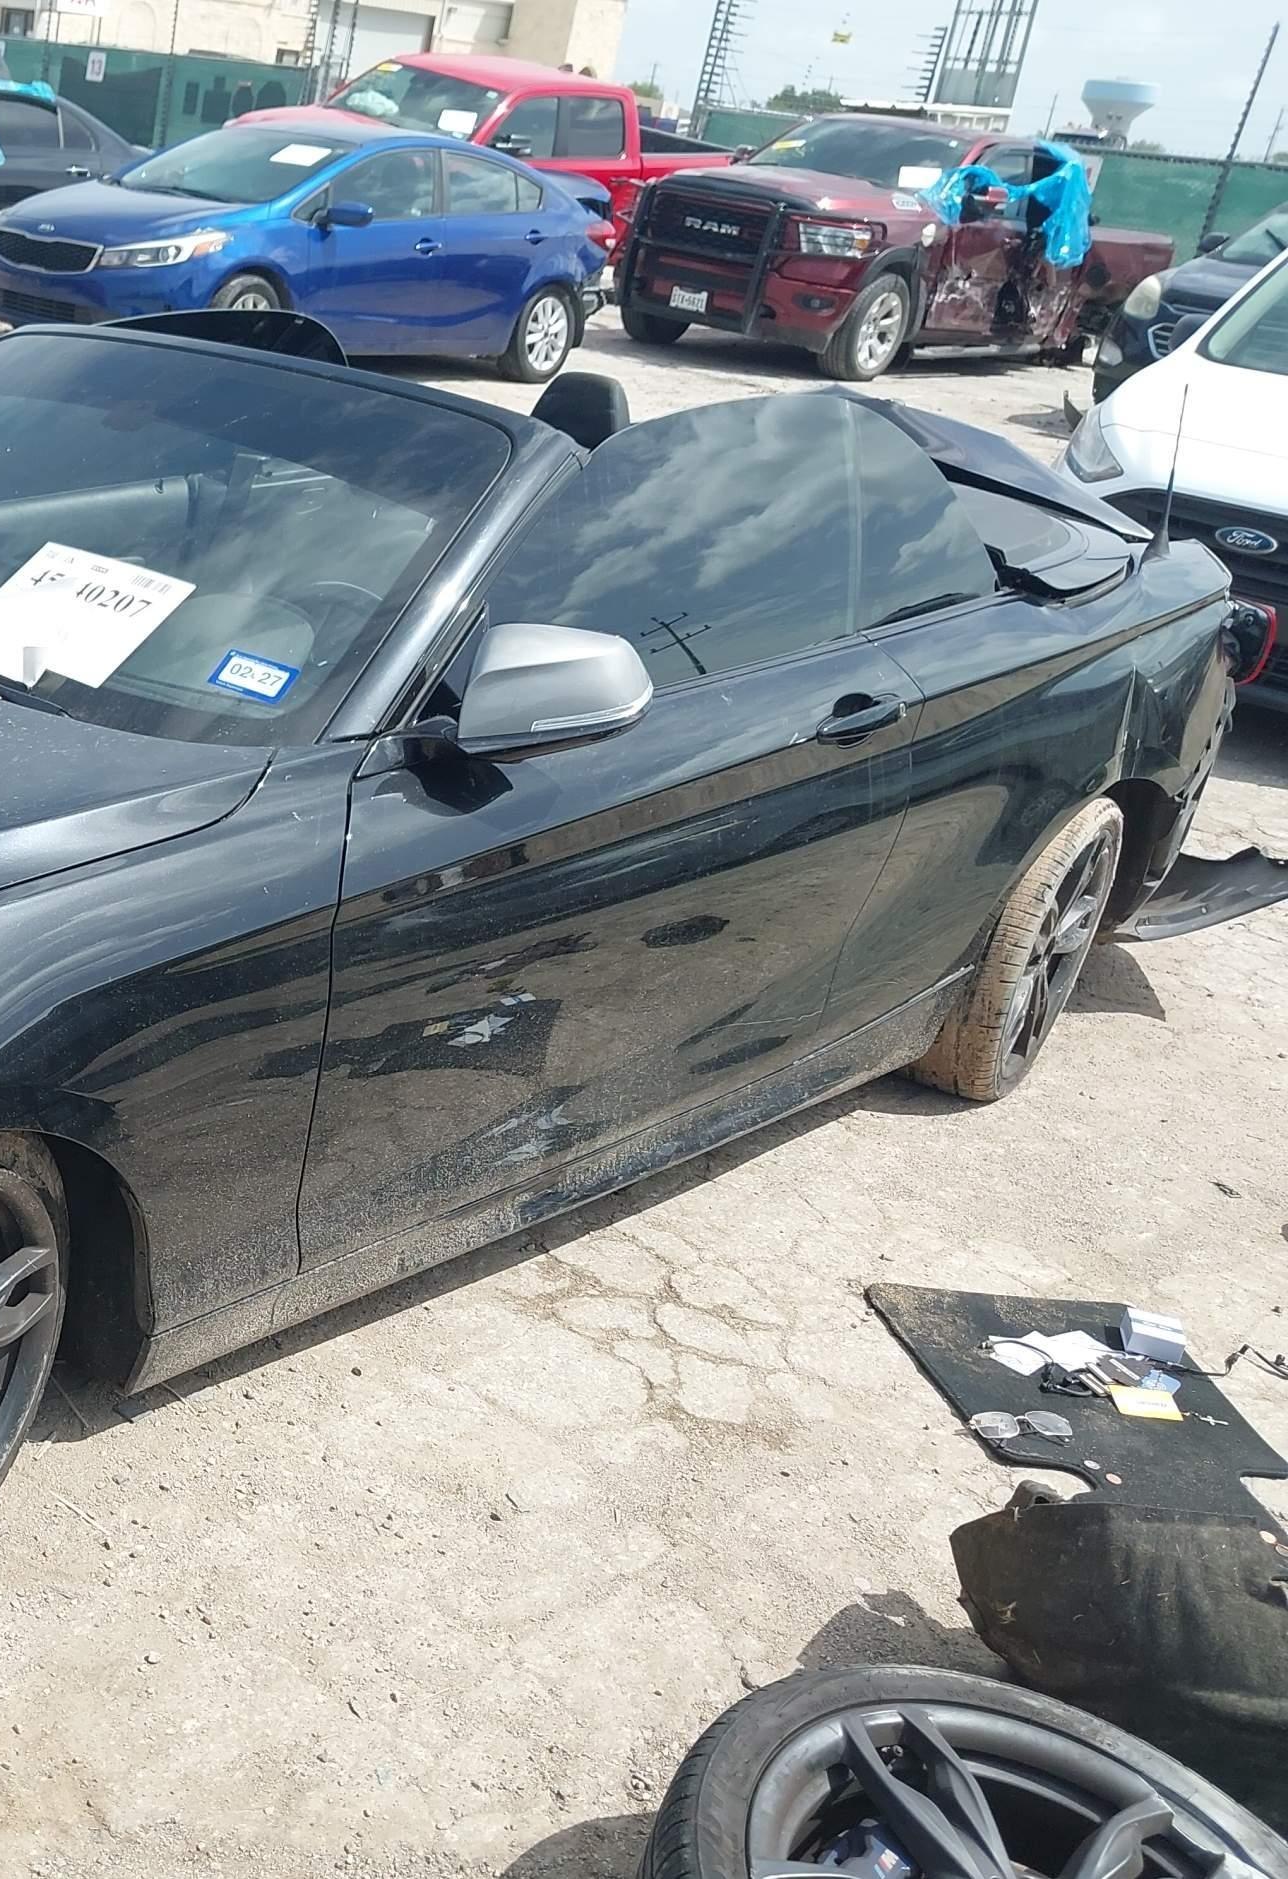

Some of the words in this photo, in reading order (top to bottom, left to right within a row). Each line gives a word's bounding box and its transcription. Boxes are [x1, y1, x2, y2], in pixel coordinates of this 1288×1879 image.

[685, 216, 740, 236] RAM
[1226, 530, 1263, 546] Ford
[257, 672, 283, 687] 27
